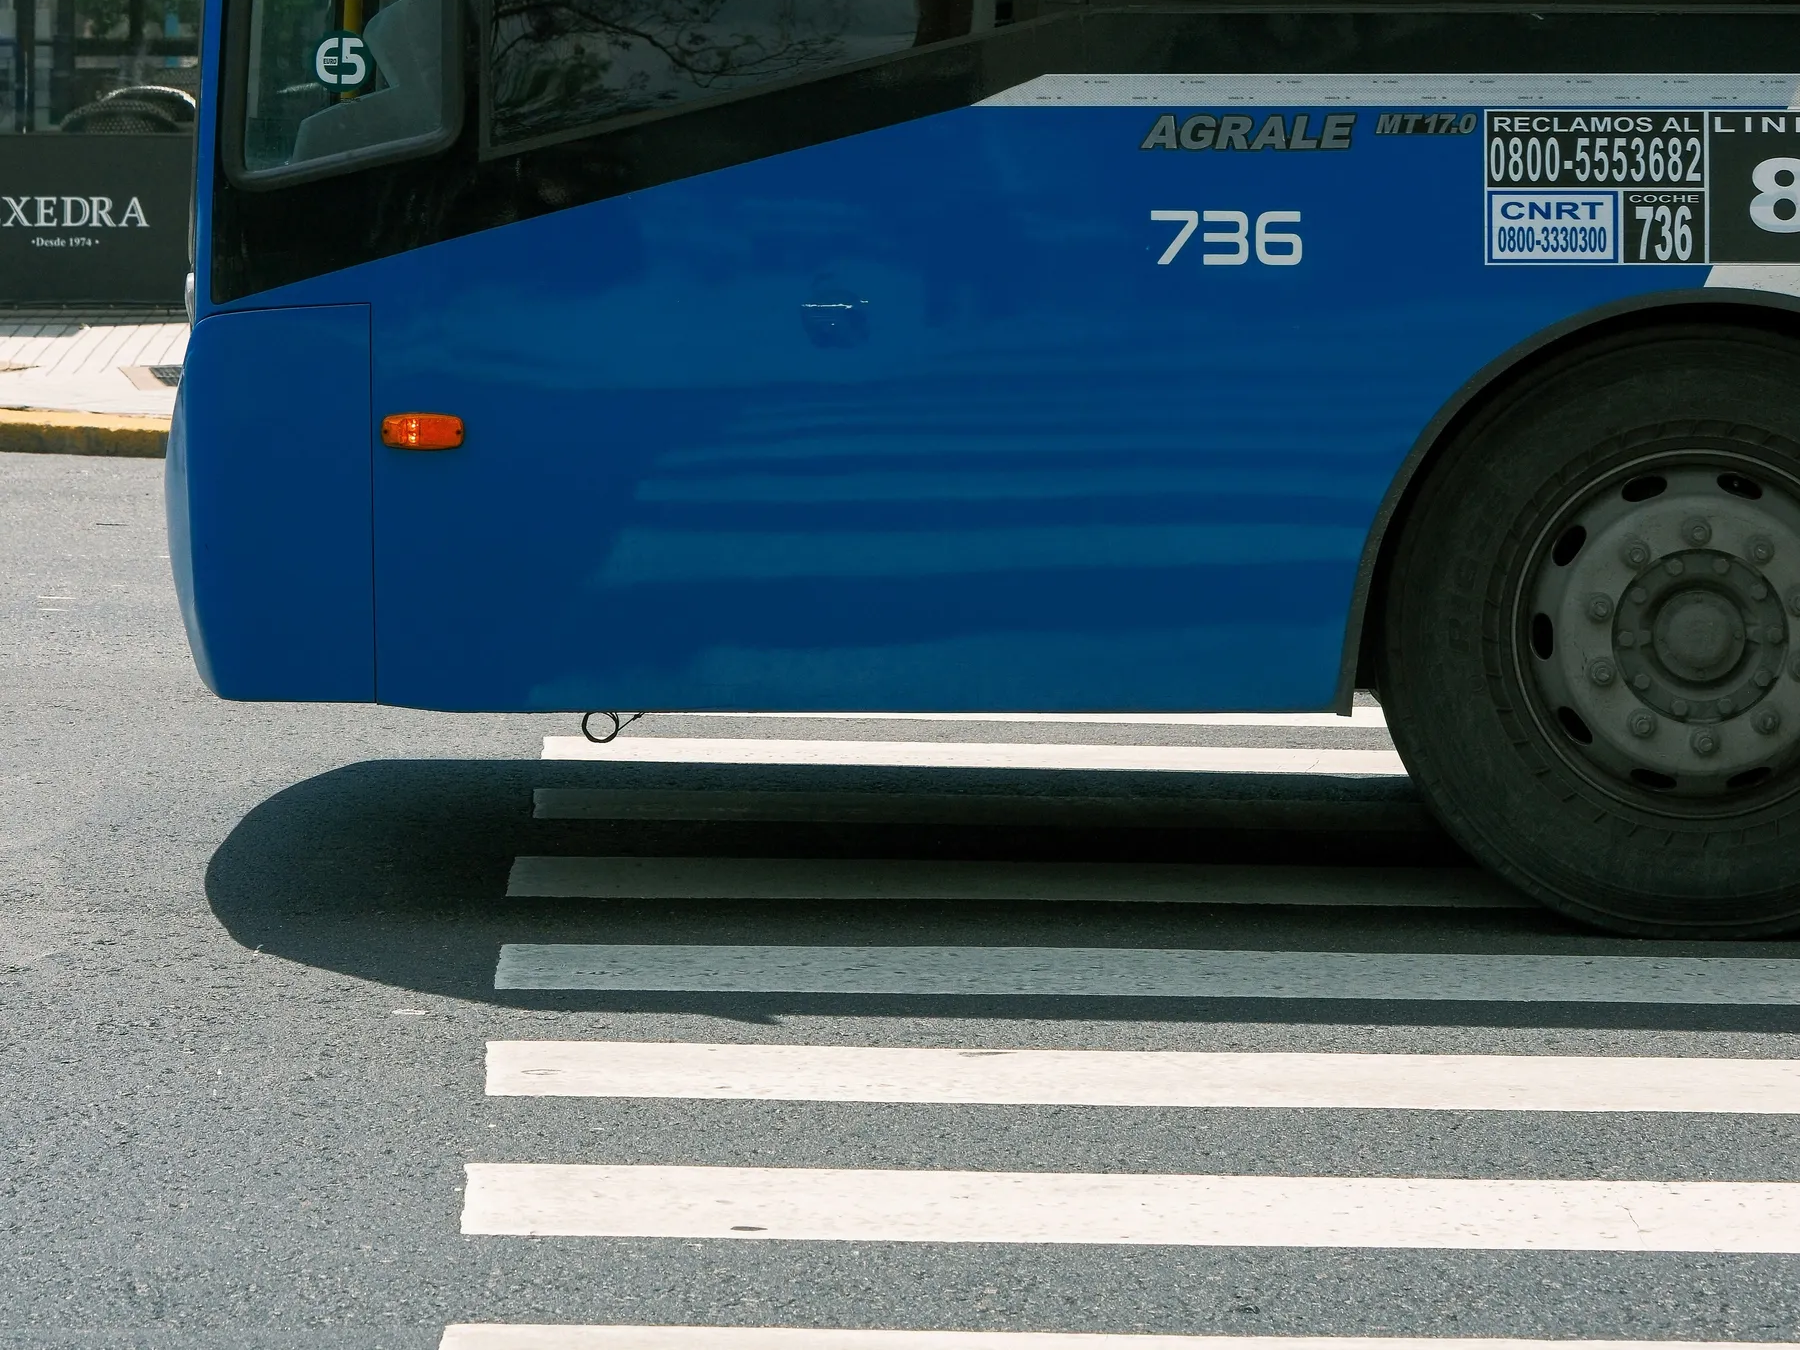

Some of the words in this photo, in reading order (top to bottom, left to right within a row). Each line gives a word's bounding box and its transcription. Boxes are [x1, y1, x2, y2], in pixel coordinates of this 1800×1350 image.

[1140, 114, 1355, 149] AGRALE
[1493, 116, 1653, 133] RECLAMOS
[1661, 117, 1700, 133] AL
[1490, 136, 1702, 183] 0800-5553682
[0, 196, 150, 227] XEDRA
[1500, 201, 1604, 220] CNRT
[1628, 194, 1700, 204] COCHE
[69, 237, 92, 247] 1974
[1151, 210, 1303, 266] 736
[1498, 226, 1607, 253] 0800-3330300
[1635, 205, 1693, 261] 736
